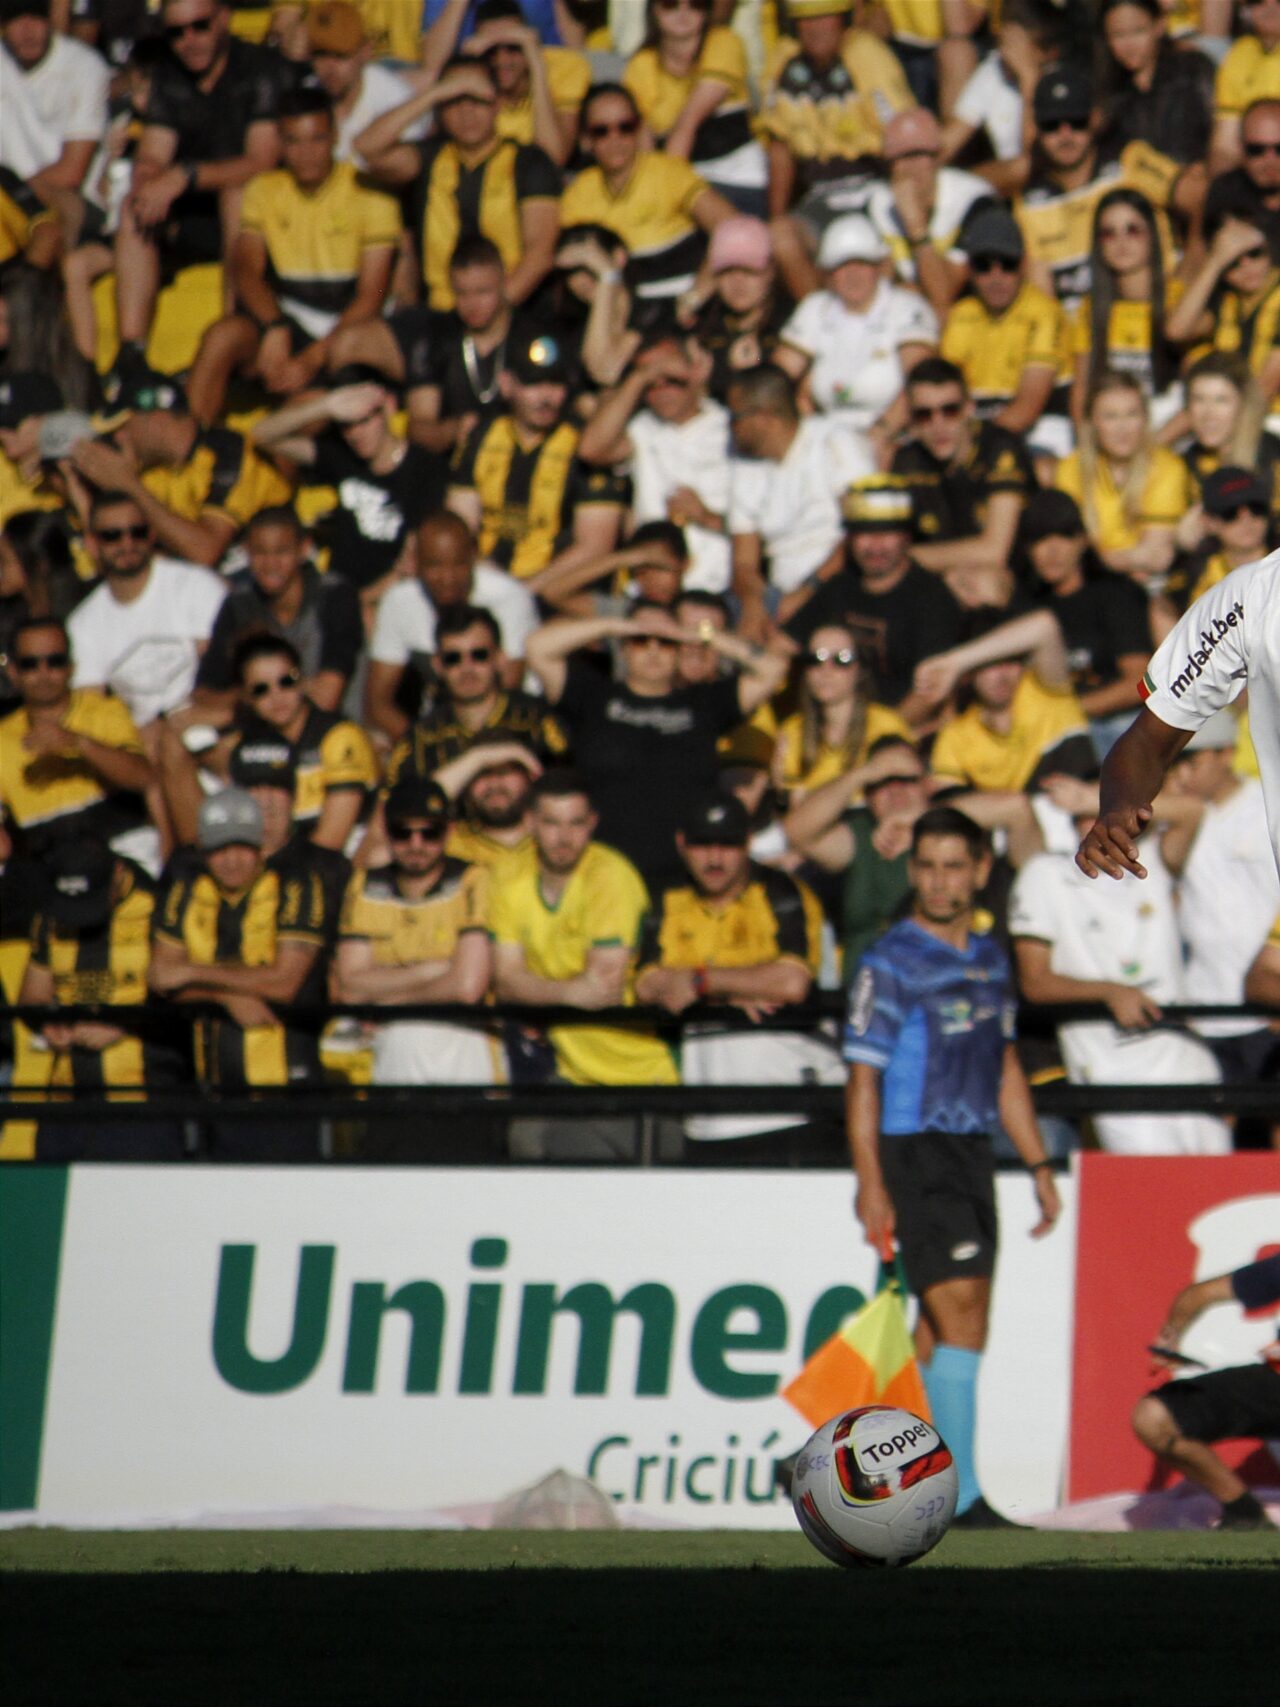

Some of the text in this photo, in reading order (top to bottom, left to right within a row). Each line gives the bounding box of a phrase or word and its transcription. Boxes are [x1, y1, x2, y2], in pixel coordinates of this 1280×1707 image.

[1170, 601, 1244, 699] mrJack.bet
[588, 1430, 782, 1504] Criciú
[861, 1422, 930, 1464] Topper
